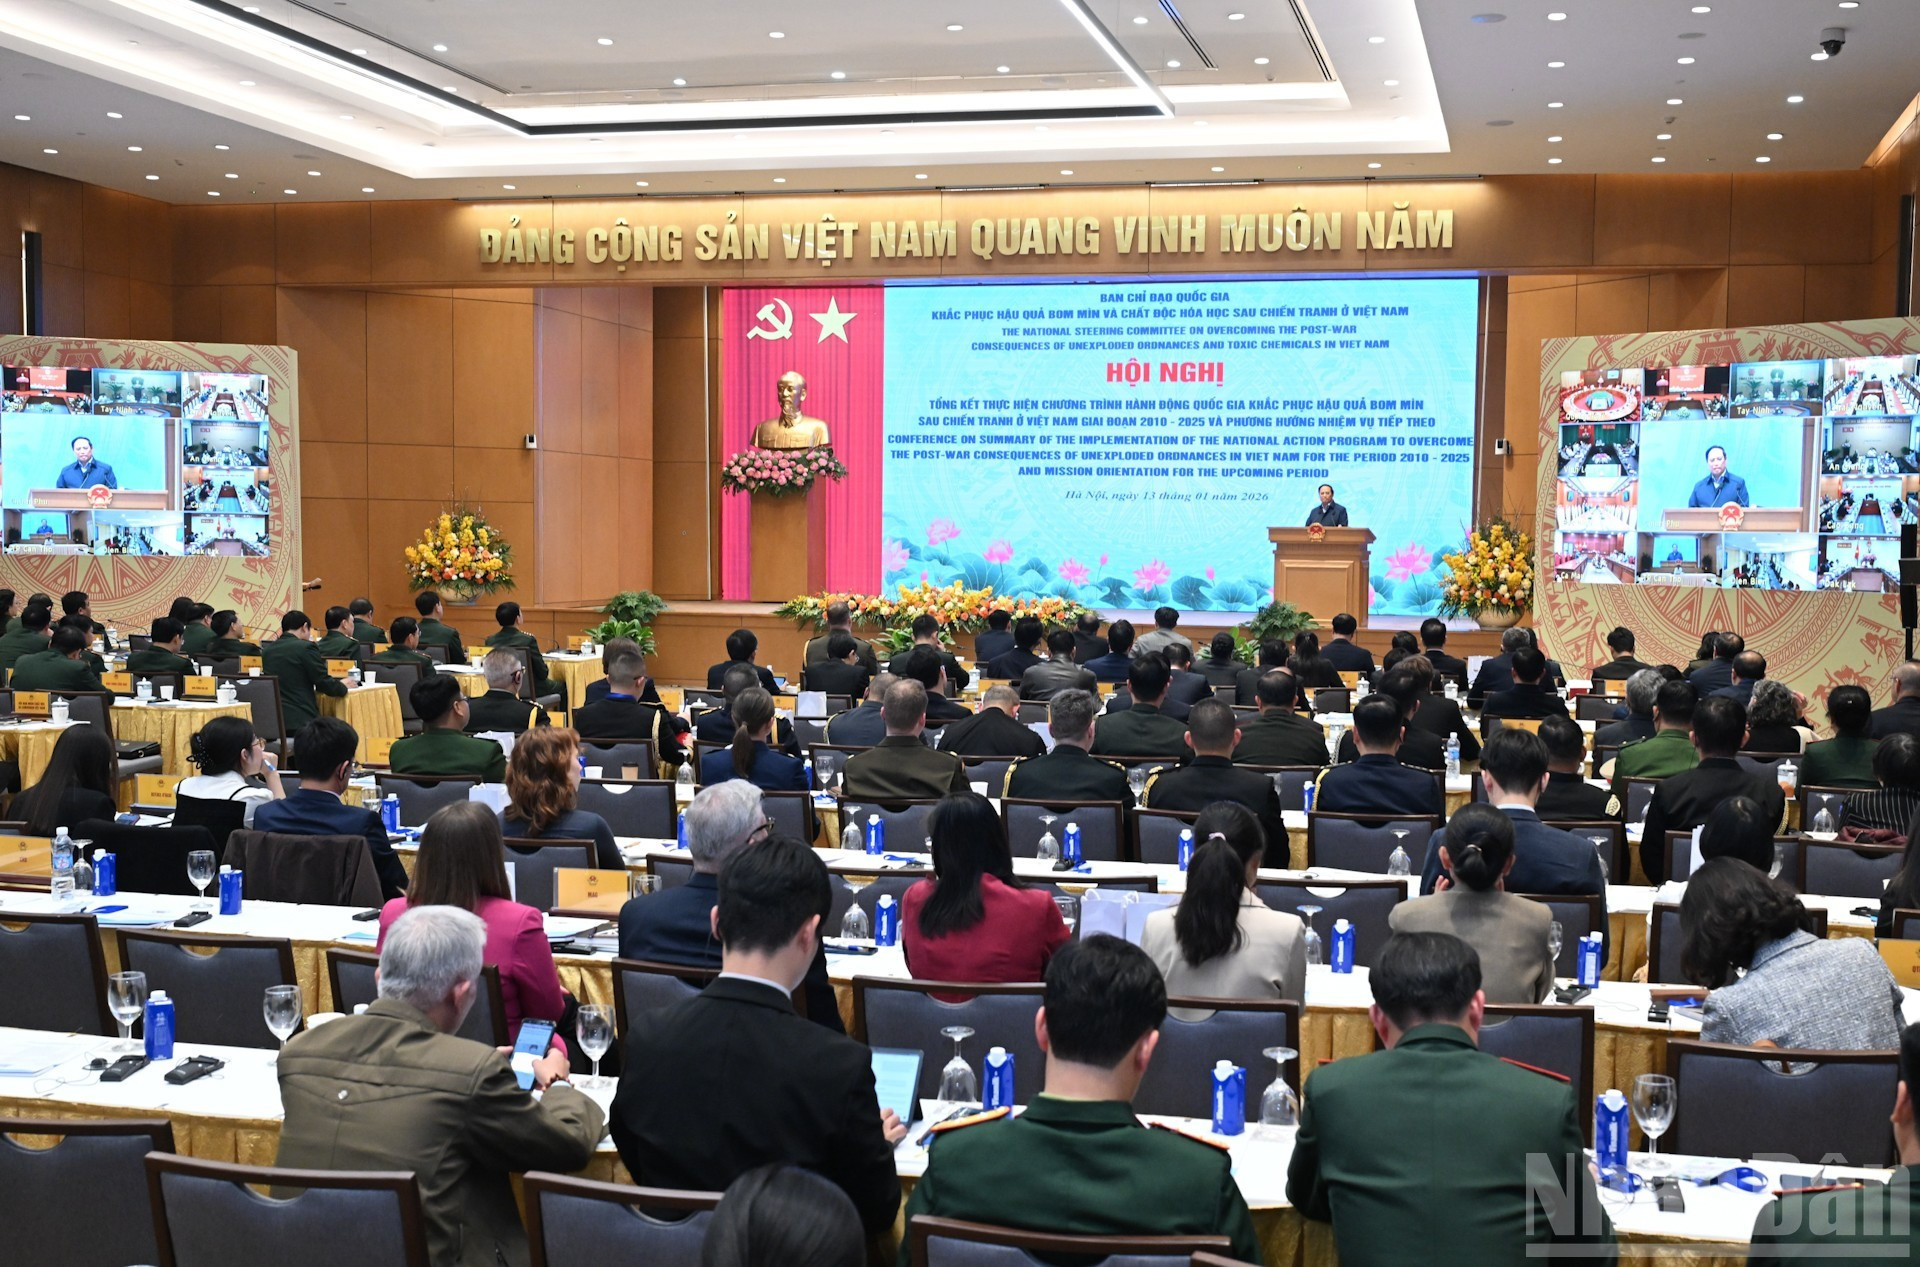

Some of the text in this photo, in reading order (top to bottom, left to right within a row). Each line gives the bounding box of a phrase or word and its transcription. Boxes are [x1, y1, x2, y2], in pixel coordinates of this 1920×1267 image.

[479, 201, 1454, 271] ĐẢNG CỘNG SẢN VIỆT NAM QUANG VINH MUÔN NĂM
[1101, 290, 1229, 304] BAN CHỈ ĐẠO QUỐC GIA
[932, 308, 960, 320] KHẮC
[965, 311, 993, 321] PHỤC
[997, 309, 1019, 321] HẬU
[1023, 307, 1045, 320] QUẢ
[1049, 310, 1073, 319] BOM
[1077, 308, 1100, 318] MÌN
[1103, 308, 1117, 318] VÀ
[1121, 306, 1150, 318] CHẤT
[1153, 307, 1176, 320] ĐỘC
[1180, 307, 1202, 317] HÓA
[1207, 308, 1229, 319] HỌC
[1233, 308, 1256, 317] SAU
[1299, 307, 1337, 316] TRANH
[1353, 305, 1377, 318] VIỆT
[1381, 307, 1408, 316] NAM
[1002, 328, 1019, 336] THE
[1023, 328, 1071, 336] NATIONAL
[1075, 327, 1123, 335] STEERING
[1127, 327, 1185, 335] COMMITTEE
[1207, 326, 1275, 334] OVERCOMING
[1279, 326, 1297, 334] THE
[1301, 325, 1356, 334] POST-WAR
[972, 342, 1050, 351] CONSEQUENCES
[1054, 342, 1065, 350] OF
[1069, 342, 1134, 350] UNEXPLODED
[1138, 341, 1199, 349] ORDNANCES
[1203, 341, 1224, 349] AND
[1228, 341, 1257, 349] TOXIC
[1261, 340, 1321, 349] CHEMICALS
[1339, 340, 1361, 348] VIET
[1365, 340, 1389, 348] NAM
[1107, 358, 1224, 387] HỘI NGHỊ
[960, 398, 979, 409] KẾT
[1014, 399, 1038, 411] HIỆN
[1090, 399, 1122, 409] TRÌNH
[1126, 399, 1155, 409] HÀNH
[1159, 399, 1189, 412] ĐỘNG
[1193, 397, 1223, 410] QUỐC
[1227, 400, 1245, 410] GIA
[1249, 397, 1279, 410] KHẮC
[1283, 400, 1313, 412] PHỤC
[1317, 399, 1340, 412] HẬU
[1344, 397, 1366, 411] QUẢ
[1370, 400, 1396, 410] BOM
[1400, 398, 1423, 410] MÌN
[918, 416, 939, 426] SAU
[978, 417, 1013, 426] TRANH
[1027, 415, 1049, 428] VIỆT
[1053, 417, 1078, 426] NAM
[1082, 417, 1103, 426] GIAI
[1107, 417, 1136, 428] ĐOẠN
[1140, 417, 1167, 426] 2010
[1178, 417, 1205, 426] 2025
[1208, 415, 1222, 426] VÀ
[1318, 415, 1356, 429] NHIỆM
[1360, 417, 1374, 429] VỤ
[1406, 417, 1435, 427] THEO
[888, 435, 1474, 446] CONFERENCE ON SUMMARY OF THE IMPLEMENTATION OF THE NATIONAL ACTION PROGRAM TO OVERCOME
[891, 450, 909, 459] THE
[914, 450, 970, 459] POST-WAR
[974, 451, 1061, 460] CONSEQUENCES
[1065, 451, 1077, 460] OF
[1082, 452, 1154, 460] UNEXPLODED
[1158, 452, 1226, 461] ORDNANCES
[1230, 452, 1241, 461] IN
[1246, 452, 1269, 461] VIET
[1273, 453, 1299, 461] NAM
[1304, 453, 1325, 461] FOR
[1329, 453, 1349, 461] THE
[1354, 453, 1396, 462] PERIOD
[1400, 453, 1429, 462] 2010
[1441, 454, 1470, 463] 2025
[1018, 467, 1328, 477] AND MISSION ORIENTATION FOR THE UPCOMING PERIOD
